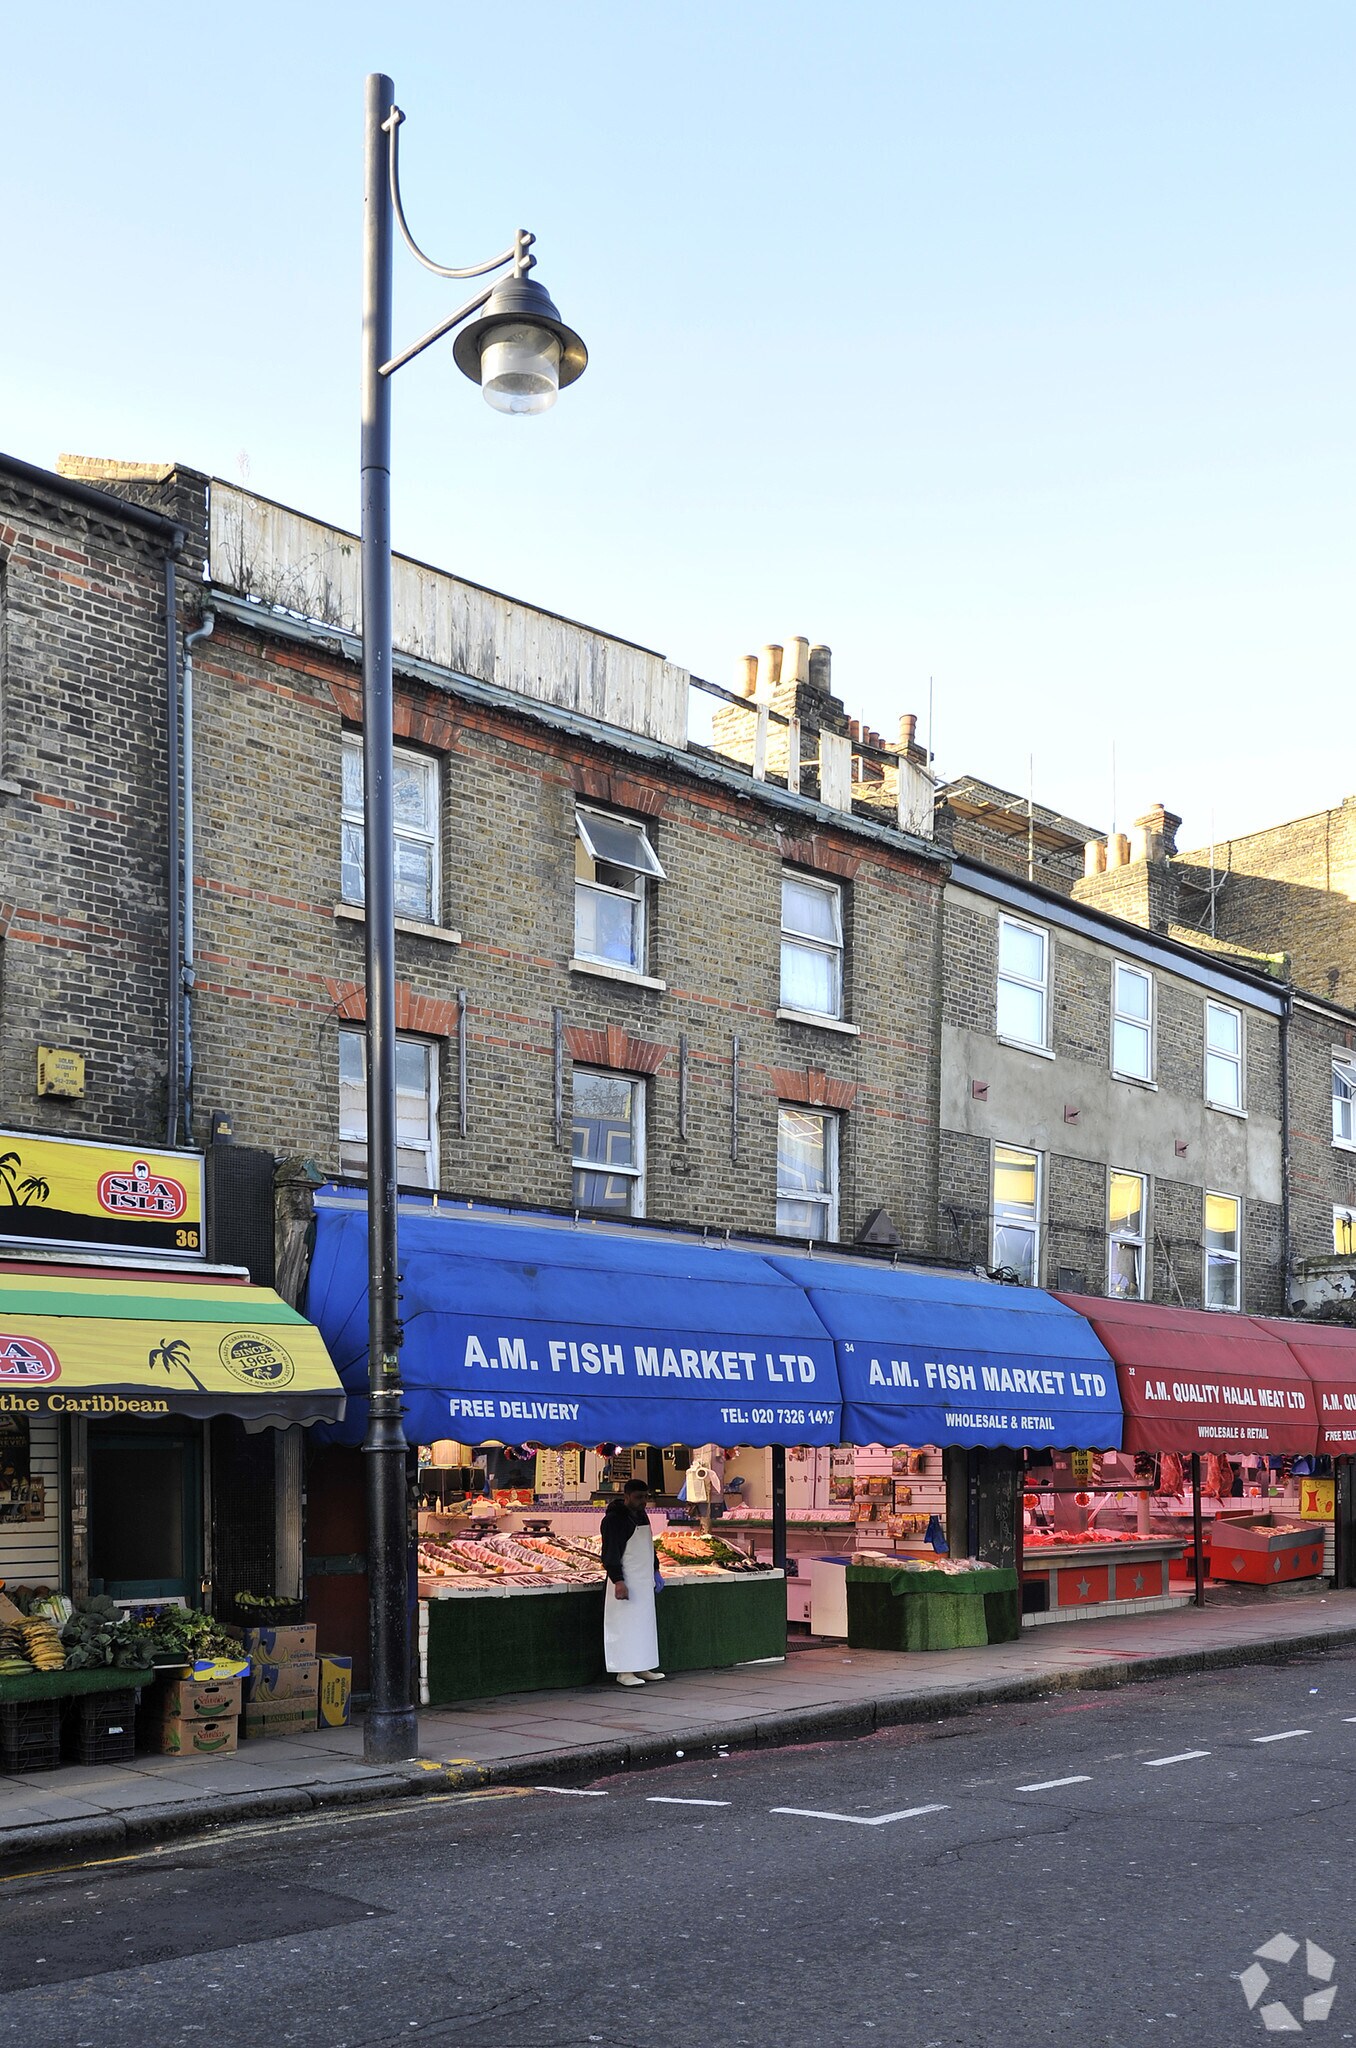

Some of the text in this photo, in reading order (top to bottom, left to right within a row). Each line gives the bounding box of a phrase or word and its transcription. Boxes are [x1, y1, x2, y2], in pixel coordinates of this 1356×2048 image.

[55, 1063, 79, 1072] SECURITY
[109, 1178, 172, 1197] SEA
[107, 1192, 176, 1213] ISLE
[176, 1229, 198, 1248] 36
[232, 1345, 268, 1358] SINCE
[844, 1343, 855, 1352] 34
[239, 1353, 276, 1369] 1965
[464, 1335, 816, 1383] A.M. FISH MARKET LTD
[869, 1359, 1106, 1397] A.M. FISH MARKET LTD
[0, 1394, 169, 1412] the Caribbean
[1145, 1380, 1306, 1409] A.M. QUALITY HALAL MEAT LTD
[1322, 1393, 1343, 1411] A.M.
[449, 1399, 579, 1420] FREE DELIVERY
[720, 1408, 749, 1423] TEL:
[752, 1410, 774, 1423] 020
[777, 1410, 805, 1424] 7326
[945, 1413, 1055, 1430] WHOLESALE & RETAIL
[1198, 1426, 1269, 1440] WHOLESALE & RETAIL
[1325, 1430, 1342, 1442] FREE
